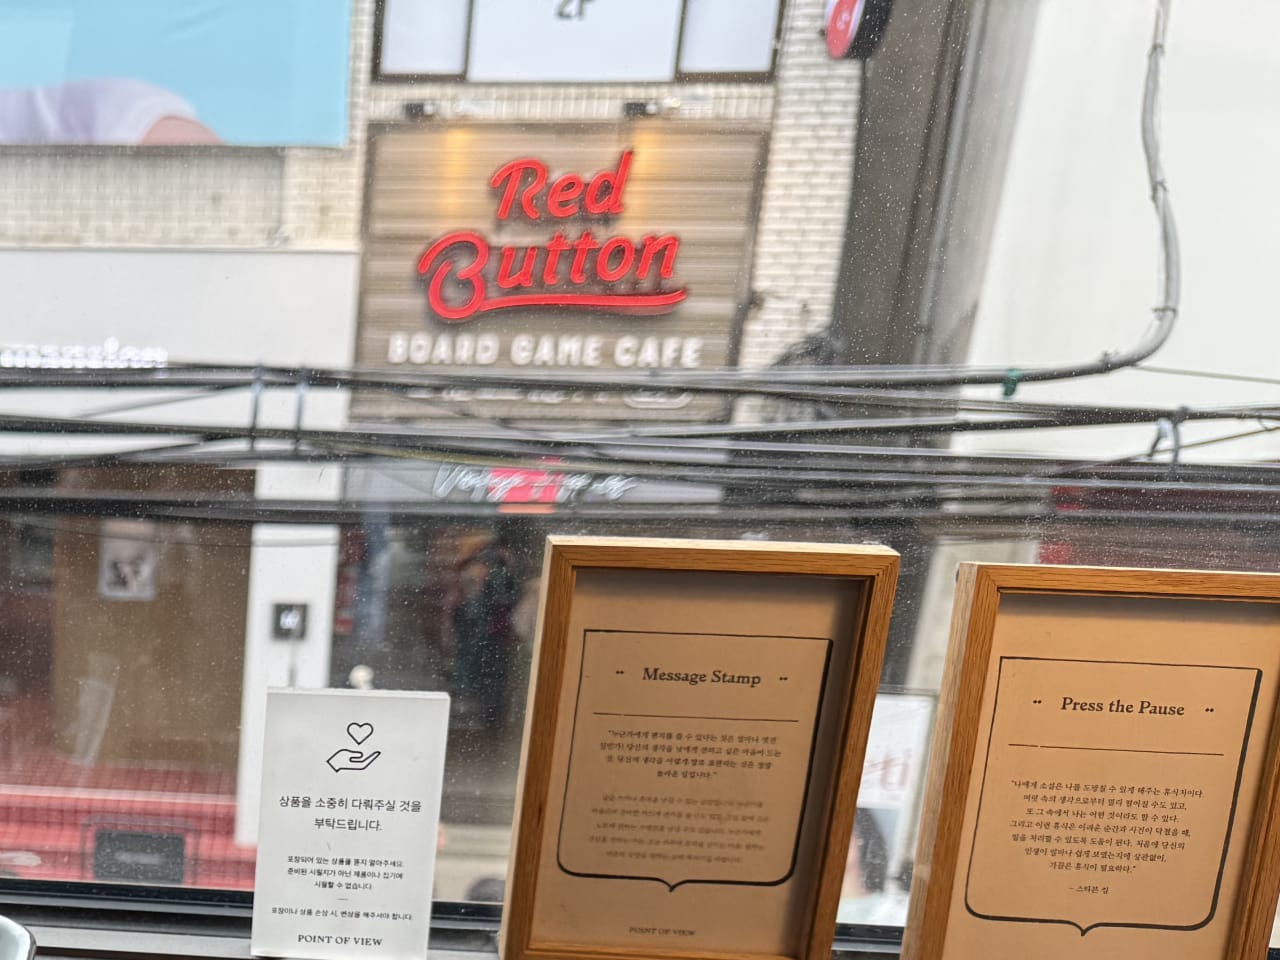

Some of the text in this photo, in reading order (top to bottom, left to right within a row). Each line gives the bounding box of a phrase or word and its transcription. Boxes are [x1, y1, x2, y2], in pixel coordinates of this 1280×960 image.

[490, 149, 633, 221] Red
[417, 230, 688, 320] Button
[388, 334, 705, 369] BOARD GAME CAFE
[643, 668, 762, 687] Message Stamp
[1060, 696, 1185, 716] Press the Pause
[279, 795, 421, 812] 상품을 소중히 다뤄주실 것을
[314, 818, 382, 832] 부탁드립니다.
[297, 934, 383, 946] POINT OF VIEW
